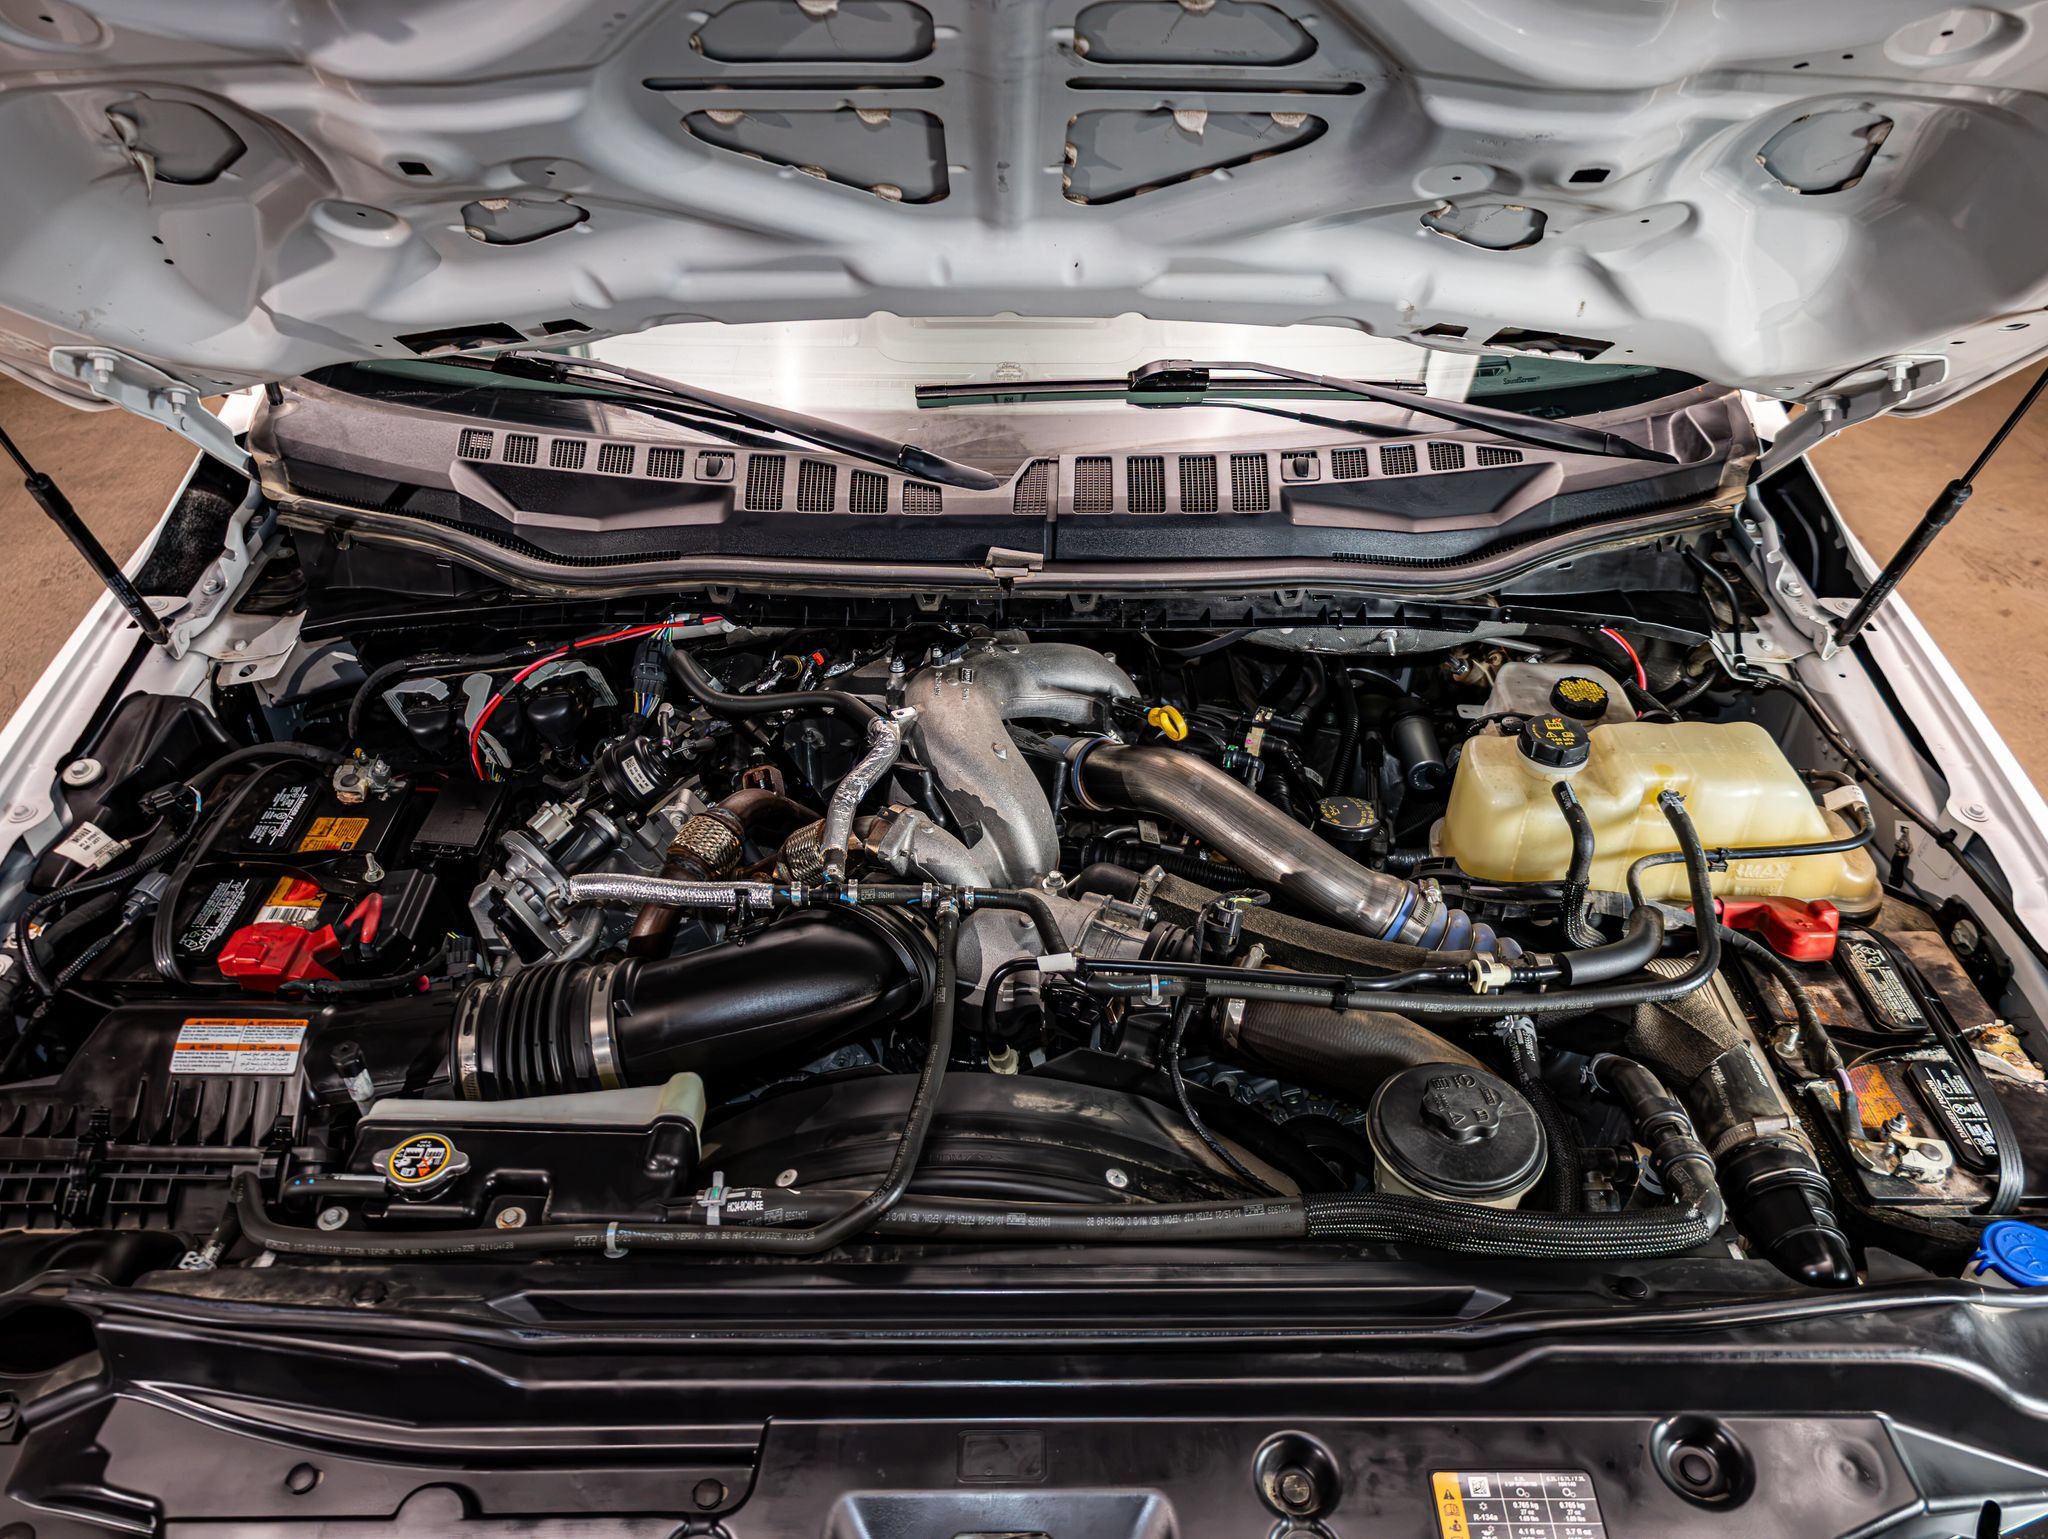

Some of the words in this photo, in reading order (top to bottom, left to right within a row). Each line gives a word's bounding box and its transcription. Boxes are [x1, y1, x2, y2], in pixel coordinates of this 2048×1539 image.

[1530, 1502, 1539, 1510] kg
[1577, 1502, 1586, 1510] kg
[1473, 1513, 1498, 1521] R-134a
